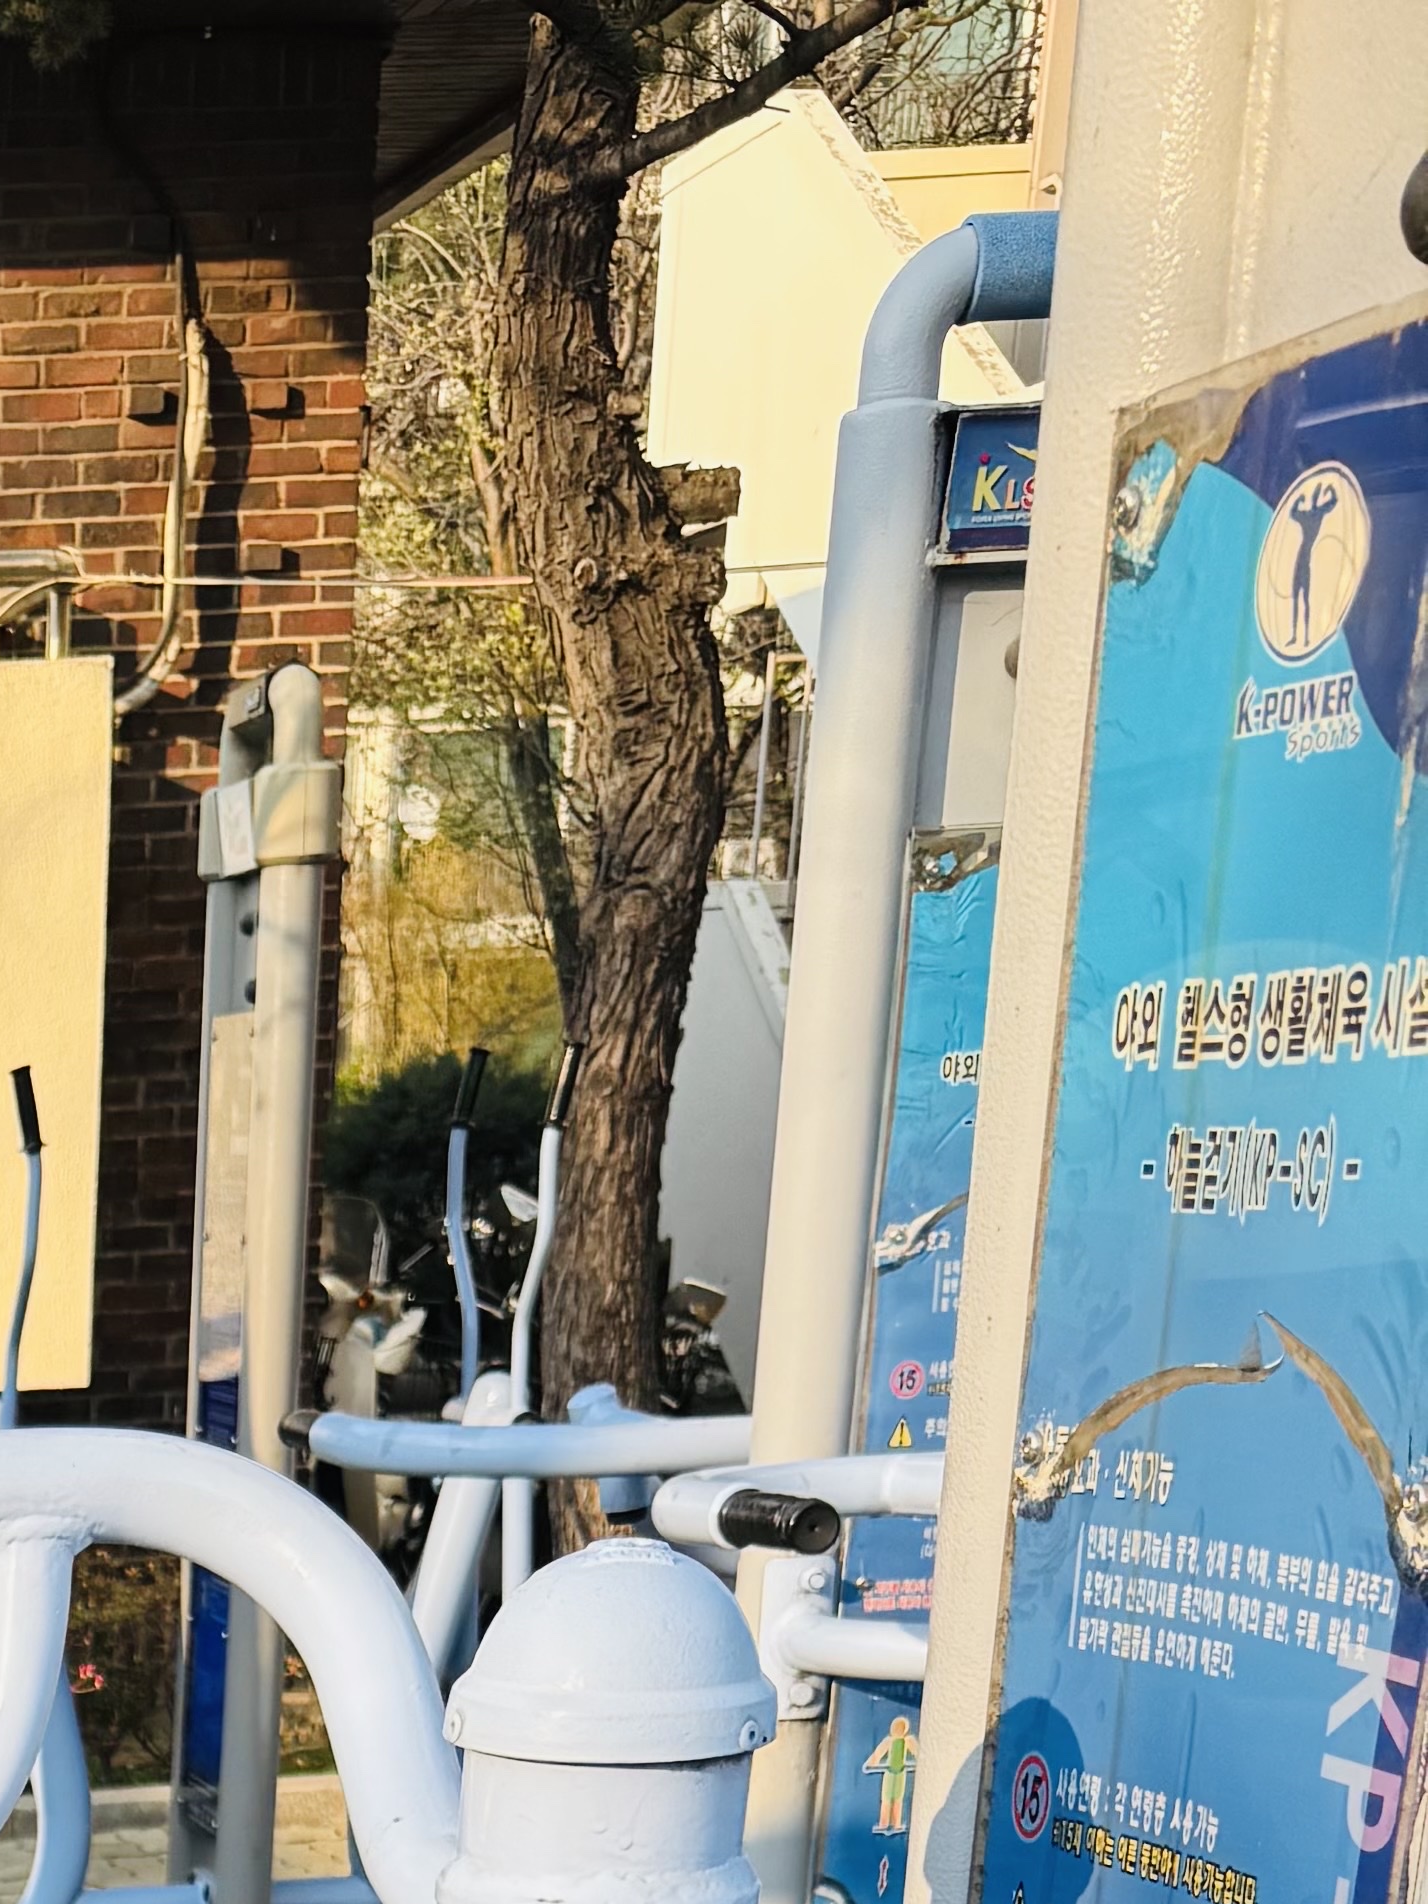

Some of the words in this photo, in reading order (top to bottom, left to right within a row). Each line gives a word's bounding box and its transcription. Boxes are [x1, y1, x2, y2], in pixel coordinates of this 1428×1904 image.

[1235, 674, 1354, 738] K-POWER
[1285, 718, 1362, 761] Sports
[1114, 983, 1164, 1068] 야외
[1259, 966, 1370, 1064] 생활체육
[943, 1053, 979, 1082] 야외
[1113, 1449, 1174, 1506] 신체기능
[1020, 1771, 1042, 1823] 15
[1056, 1767, 1103, 1818] 사용연령
[1114, 1781, 1127, 1822] 각
